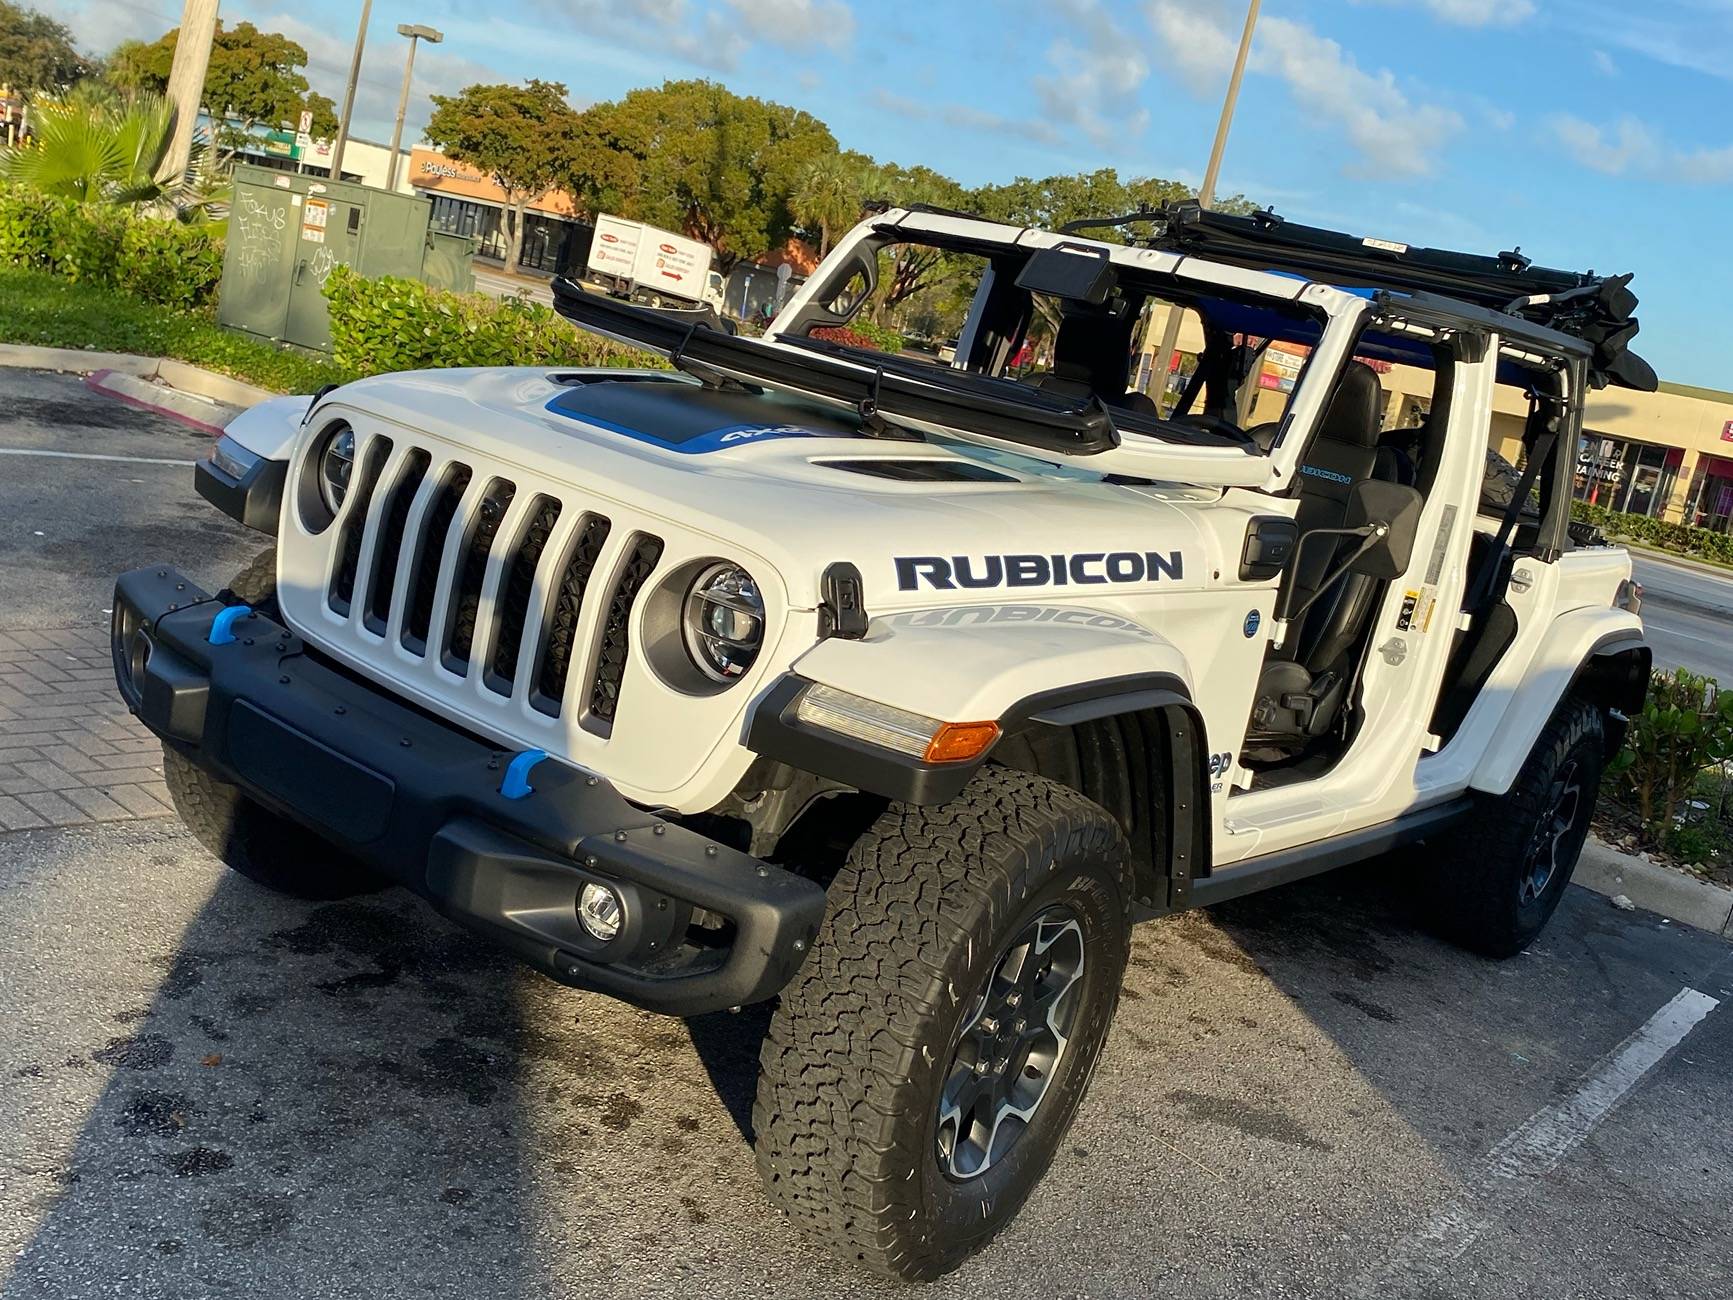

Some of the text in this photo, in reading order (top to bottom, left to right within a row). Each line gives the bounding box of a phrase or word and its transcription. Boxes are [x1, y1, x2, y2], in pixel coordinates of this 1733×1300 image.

[426, 162, 456, 179] Payless
[1579, 452, 1624, 470] CAREER
[1575, 463, 1621, 482] RAINING
[893, 551, 1184, 591] RUBICON
